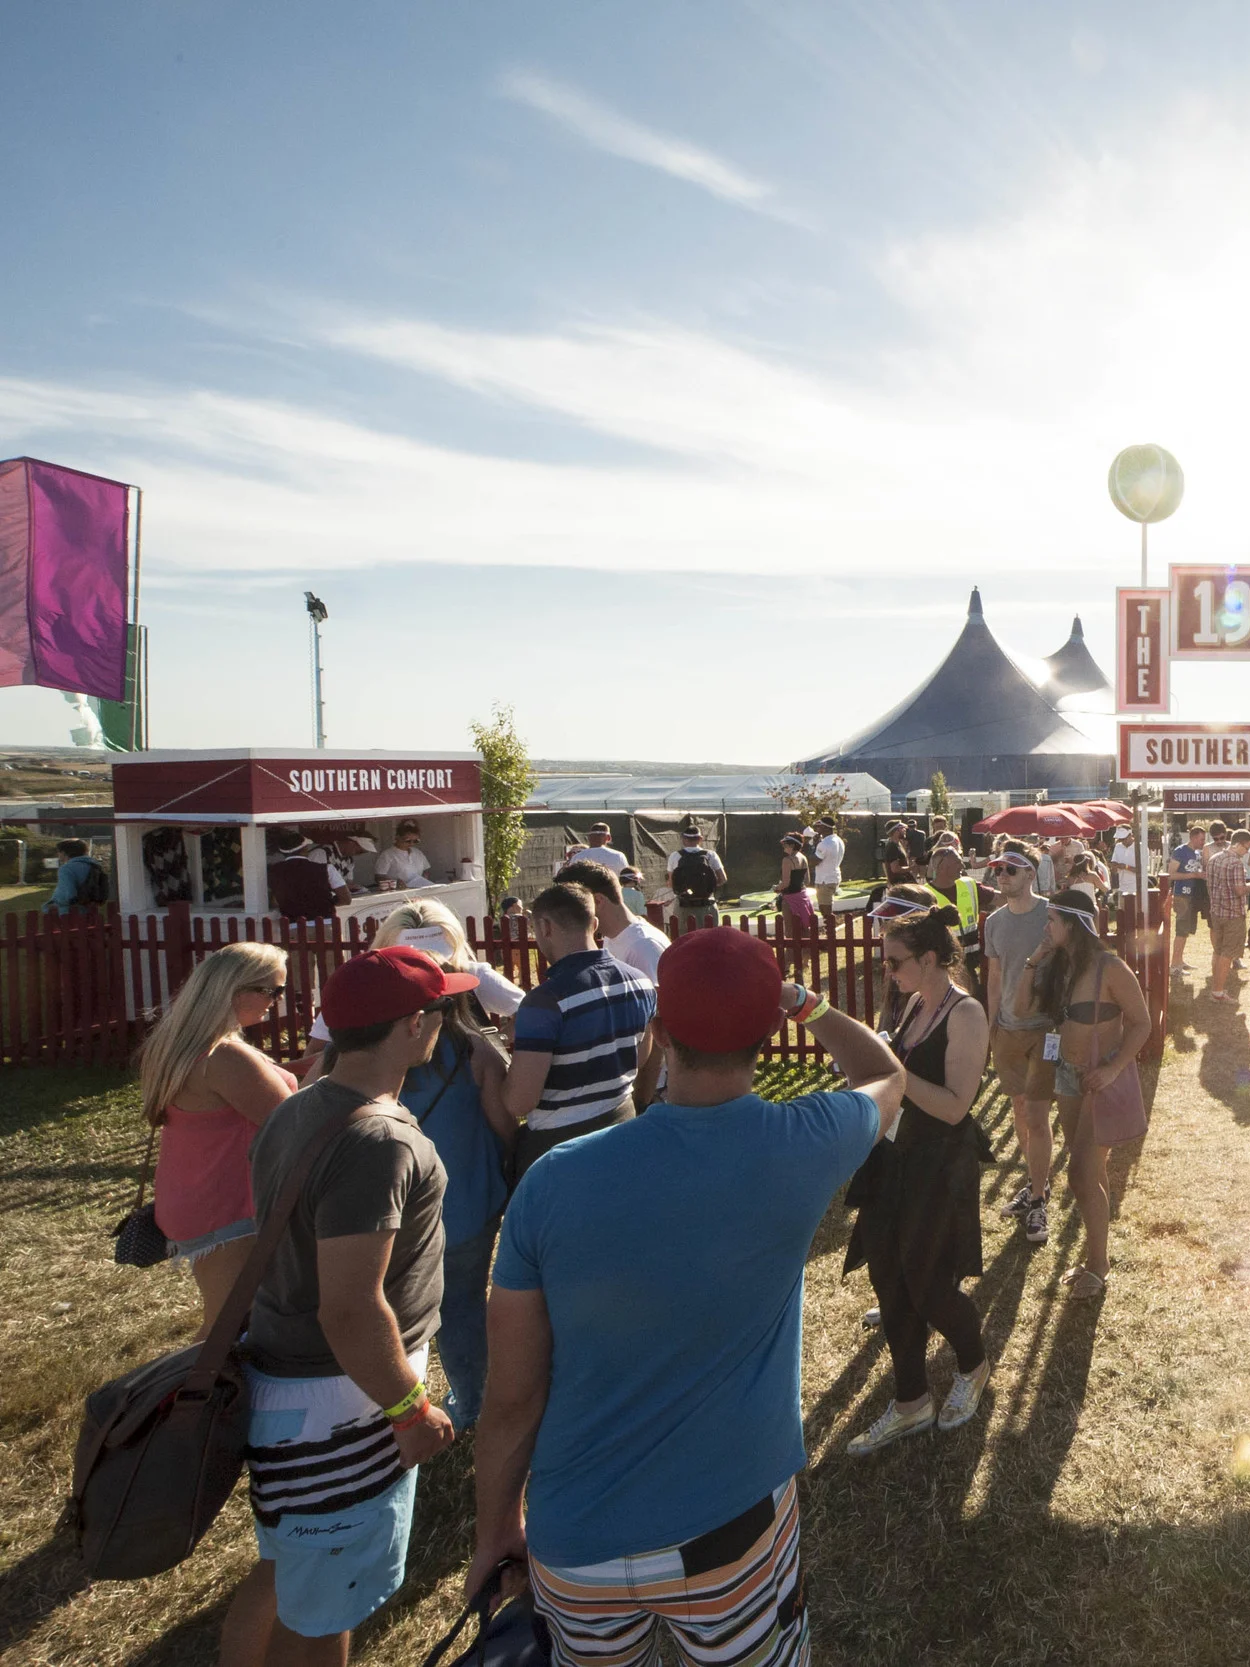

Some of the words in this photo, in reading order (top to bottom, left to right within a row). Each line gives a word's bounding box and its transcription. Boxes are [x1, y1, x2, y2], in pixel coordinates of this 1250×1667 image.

[1137, 605, 1150, 698] THE
[288, 769, 381, 793] SOUTHERN
[387, 769, 453, 790] COMFORT
[1173, 792, 1210, 802] SOUTHERN
[1212, 792, 1244, 802] COMFORT
